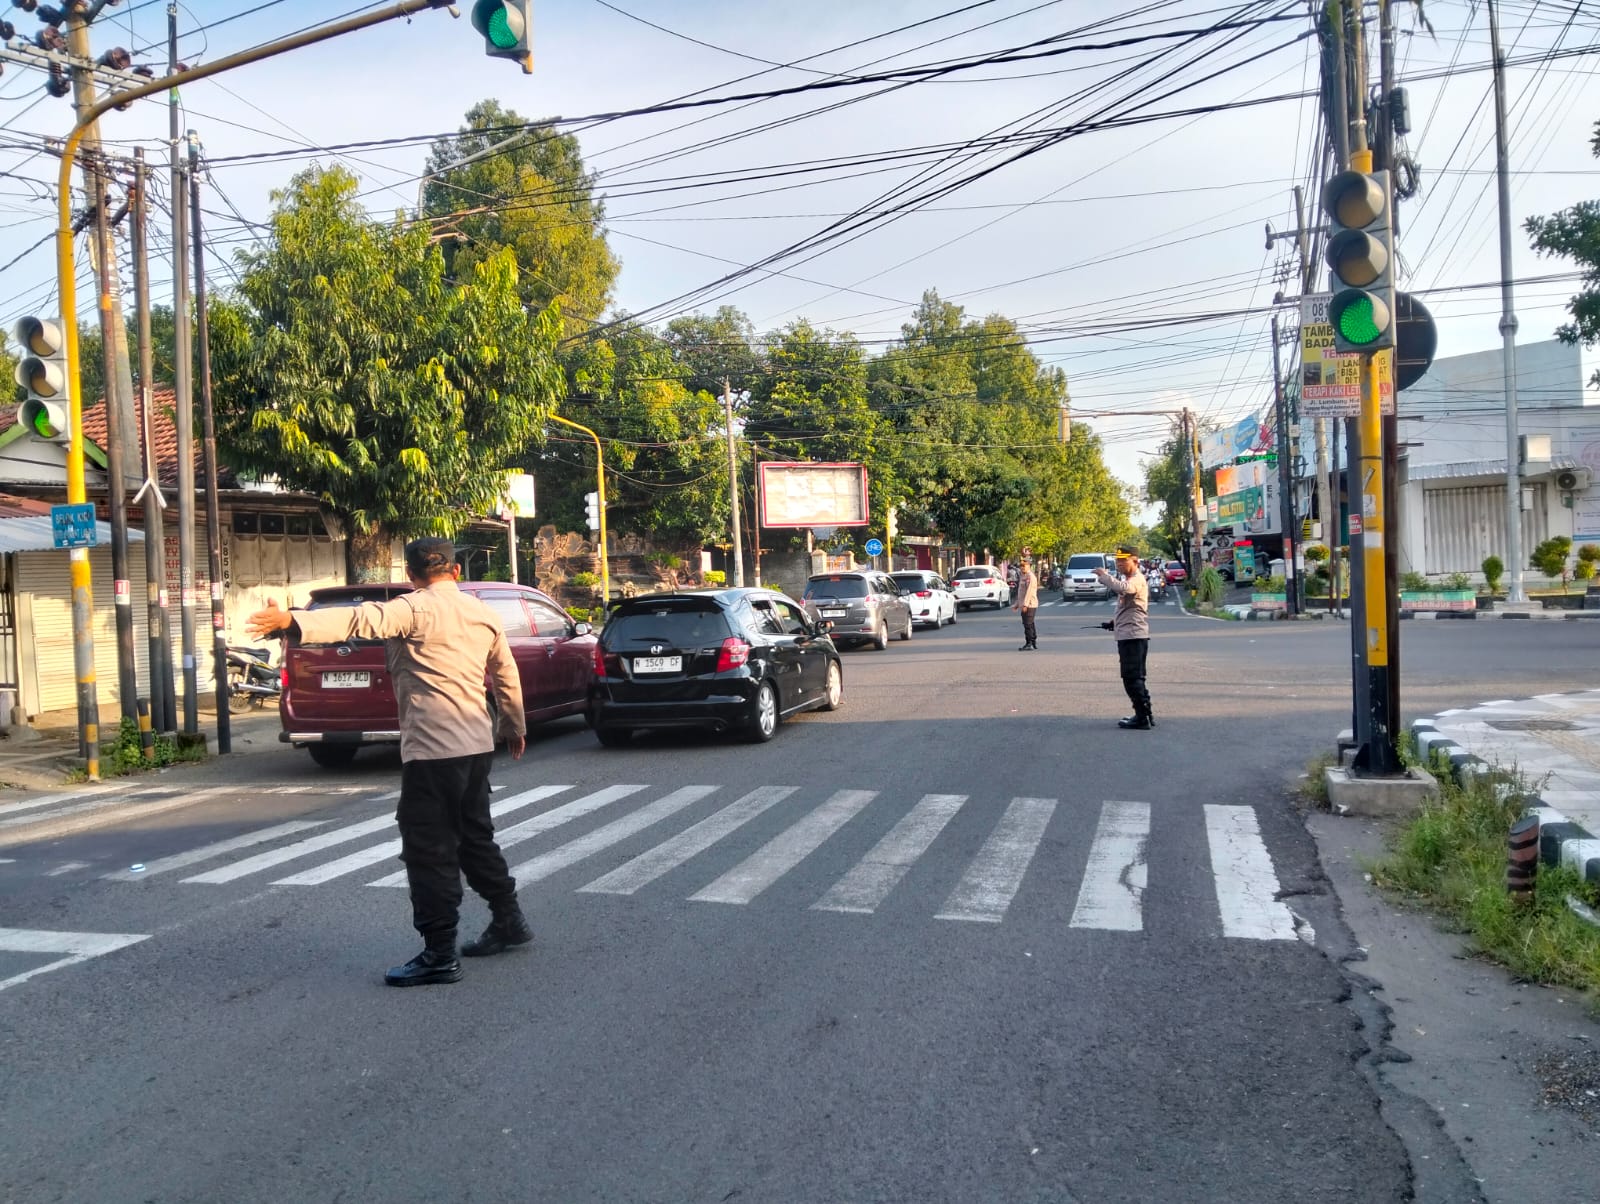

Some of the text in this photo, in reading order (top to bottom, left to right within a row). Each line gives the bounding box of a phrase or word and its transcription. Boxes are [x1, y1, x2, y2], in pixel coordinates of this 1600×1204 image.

[1304, 325, 1336, 337] TAMB
[1305, 386, 1328, 397] TERAPI
[1329, 385, 1345, 396] KAKI
[635, 659, 640, 668] N
[324, 672, 329, 682] N
[333, 672, 352, 682] 1617
